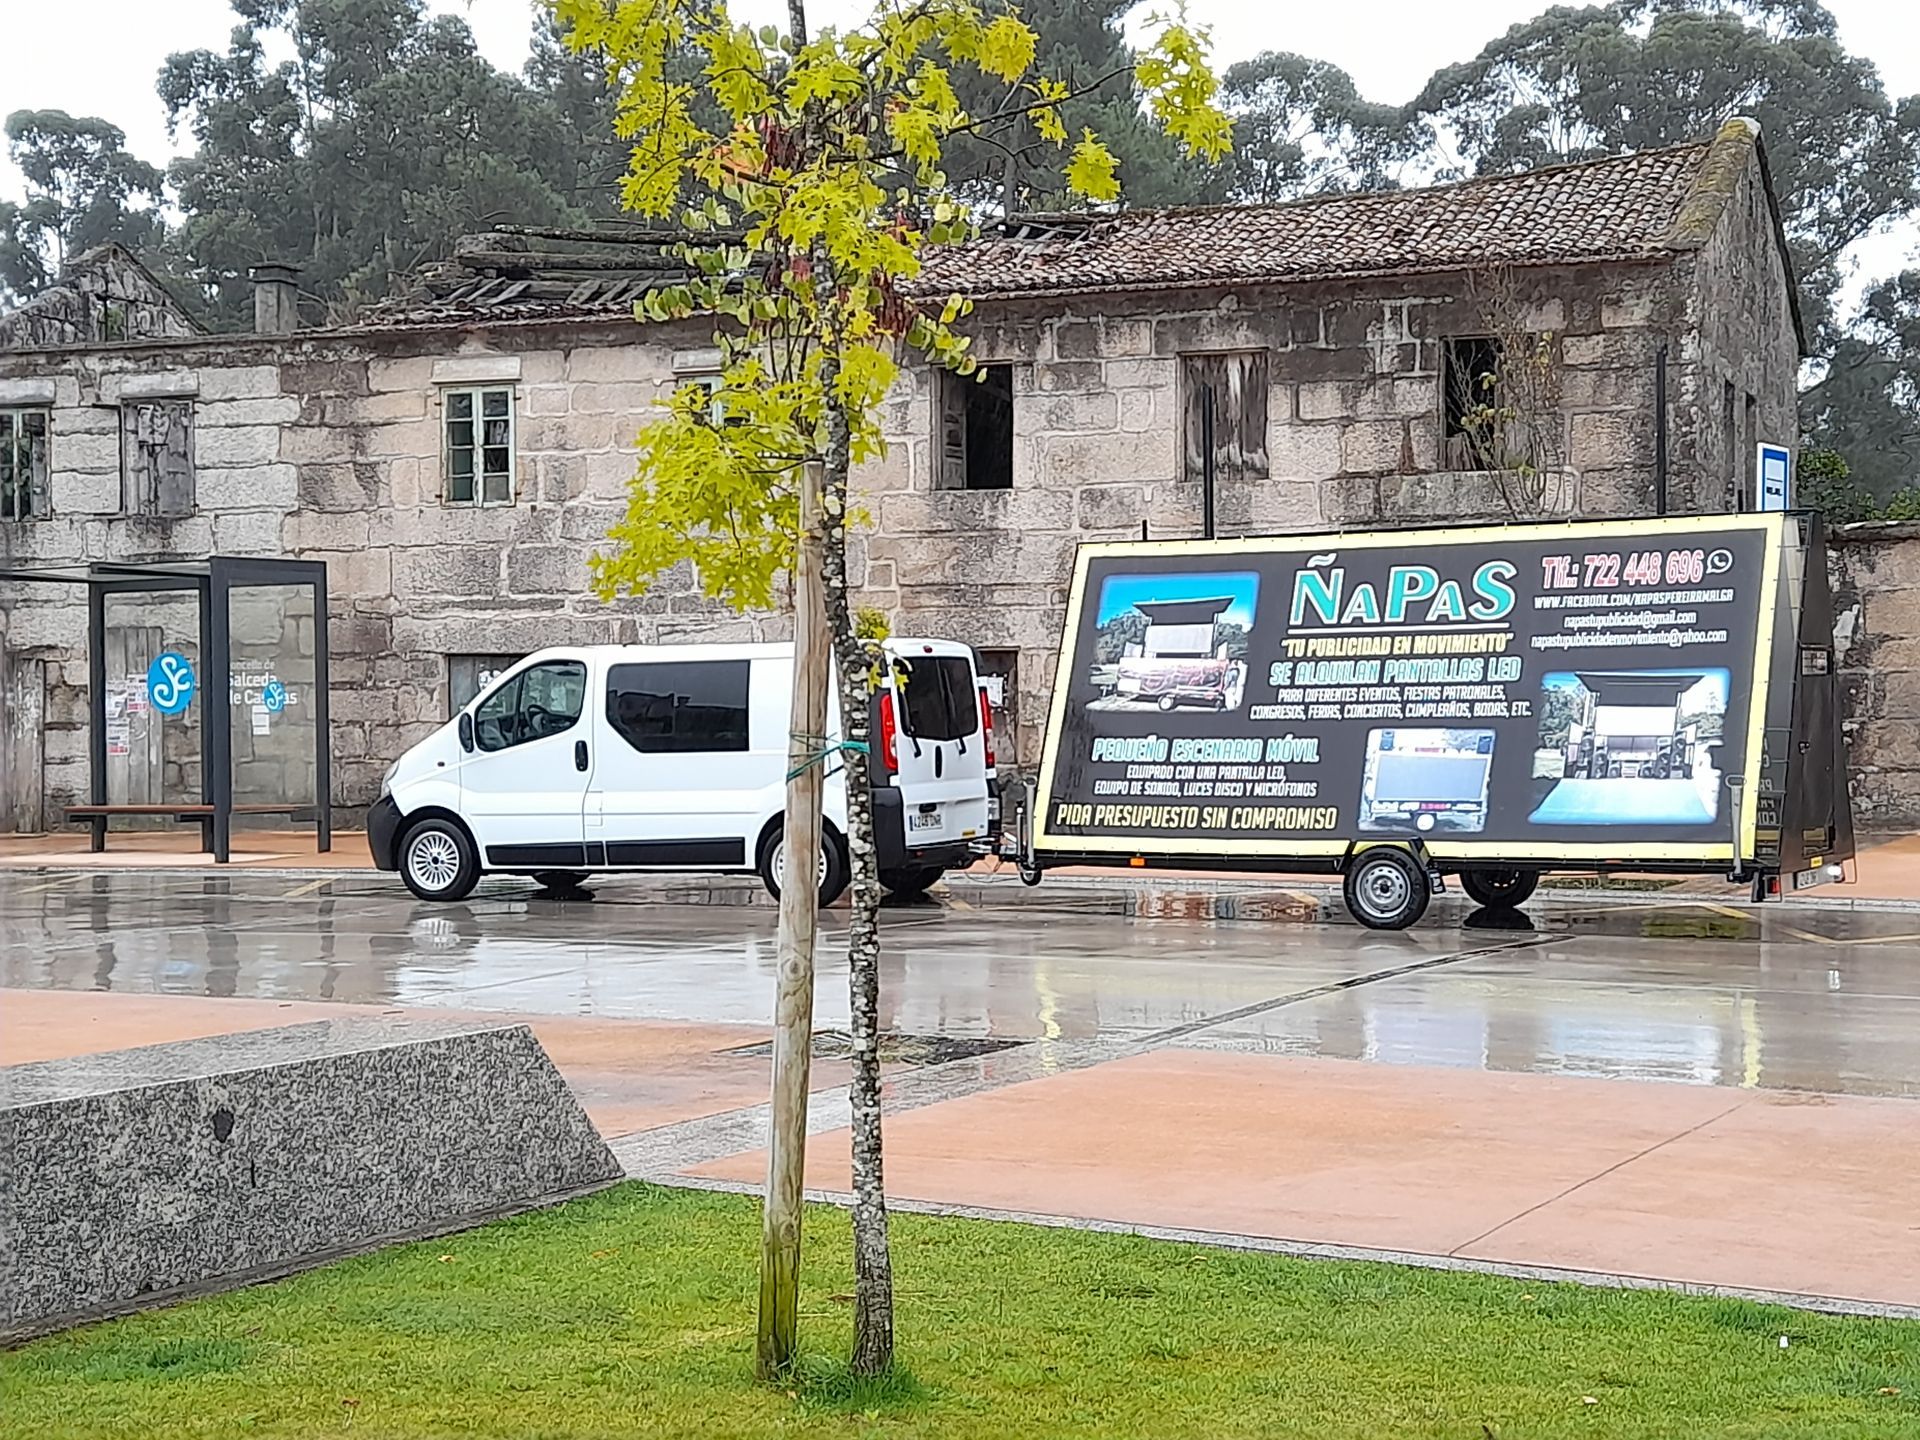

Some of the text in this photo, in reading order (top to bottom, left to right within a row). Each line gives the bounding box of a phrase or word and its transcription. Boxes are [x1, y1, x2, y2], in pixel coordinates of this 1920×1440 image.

[1584, 554, 1621, 587] 722
[1623, 552, 1662, 585] 448
[1666, 549, 1704, 584] 696
[1307, 636, 1392, 657] PUBLICIDAD
[1393, 636, 1412, 655] EN
[1269, 656, 1522, 686] SE ALQUILAN PANTALLAS LED
[1278, 684, 1506, 702] PARA DIFERENTES EVENTOS, FIESTAS PATRONALES,
[1250, 700, 1532, 720] CONGRESOS, FERIAS, CONCIERTOS, CUMPLEAÑOS, BODAS, ETC.
[1091, 734, 1320, 763] PEQUEÑO ESCENARIO MÓVIL
[1126, 764, 1287, 781] EQUIPADO CON UNA PANTALLA LED,
[1094, 780, 1317, 798] EQUIPO DE SONIDO, LUCES DISCO Y MICRÓFONOS
[1056, 804, 1338, 829] PIDA PRESUPUESTO SIN COMPROMISO
